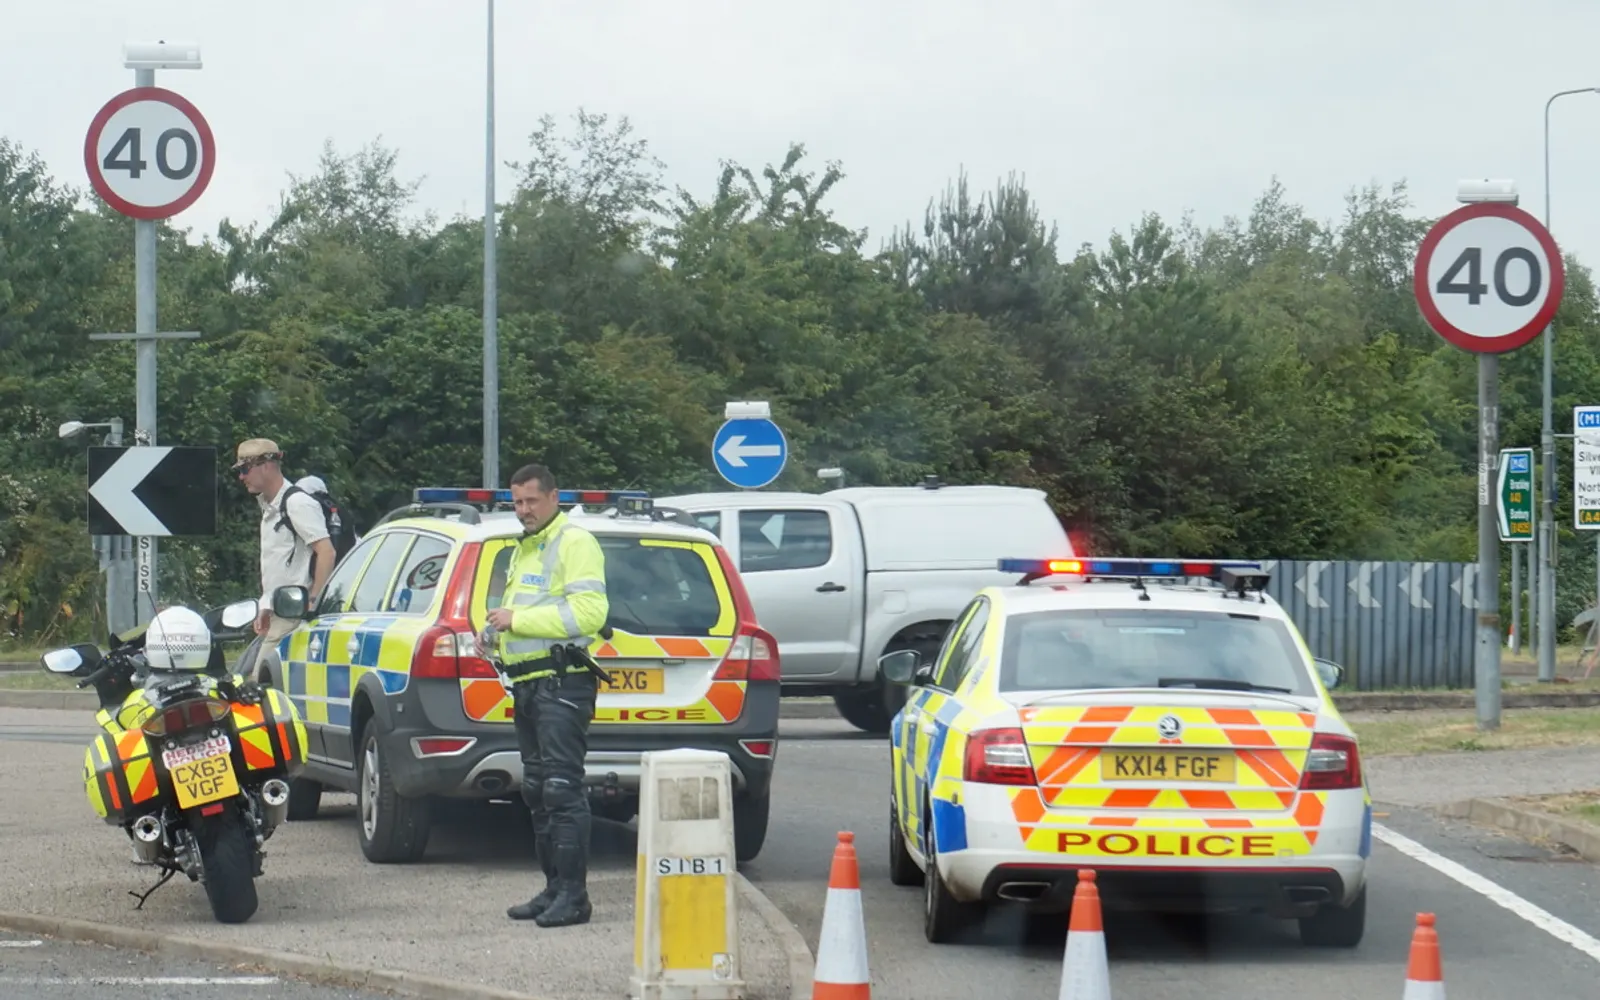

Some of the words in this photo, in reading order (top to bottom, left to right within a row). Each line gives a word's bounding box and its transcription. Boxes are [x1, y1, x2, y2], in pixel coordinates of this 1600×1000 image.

[103, 128, 197, 180] 40
[1436, 247, 1542, 307] 40
[160, 634, 197, 643] POLICE
[608, 670, 648, 690] EXG
[175, 757, 228, 785] CX63
[1115, 755, 1167, 776] KX14
[1175, 756, 1219, 778] FGF
[187, 776, 224, 799] VGF
[1057, 832, 1275, 856] POLICE
